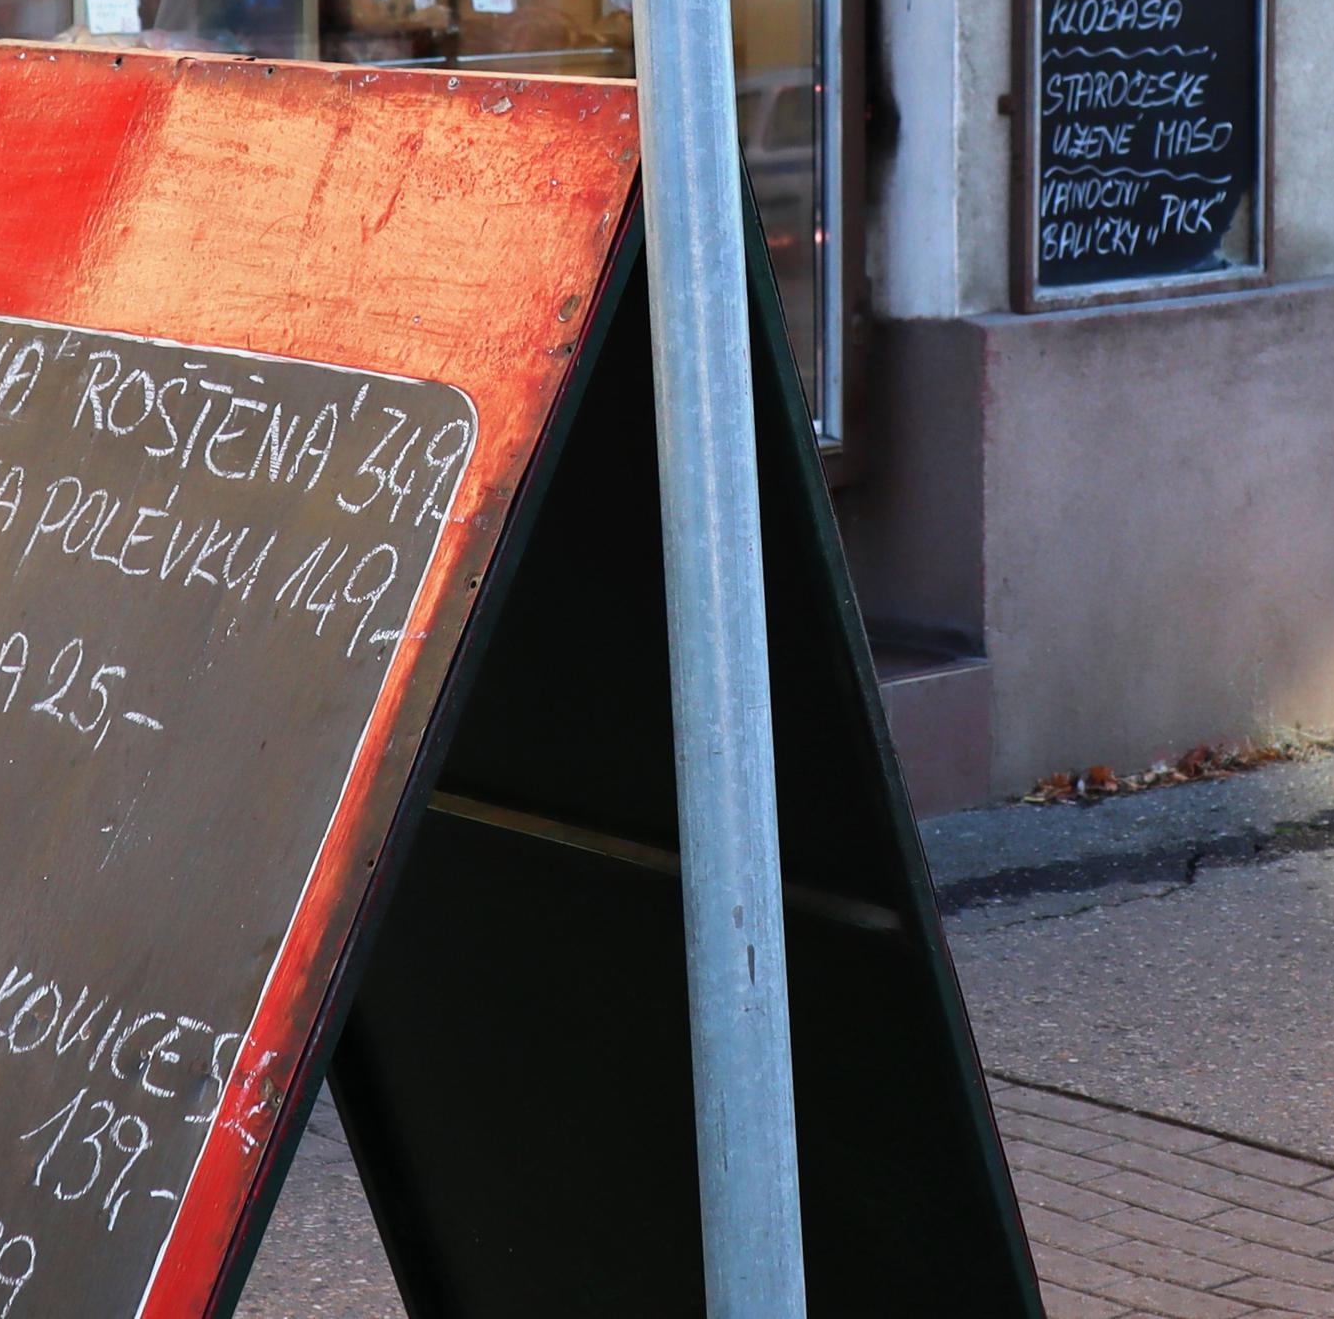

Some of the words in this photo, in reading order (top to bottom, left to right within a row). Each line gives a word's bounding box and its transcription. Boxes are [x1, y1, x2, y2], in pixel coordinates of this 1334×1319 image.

[1042, 51, 1217, 116] STAROČESKÉ
[1154, 117, 1233, 160] MASO
[1042, 215, 1141, 261] BALÍČKY
[13, 483, 276, 602] POLÉVKU
[30, 638, 164, 751] 25,-
